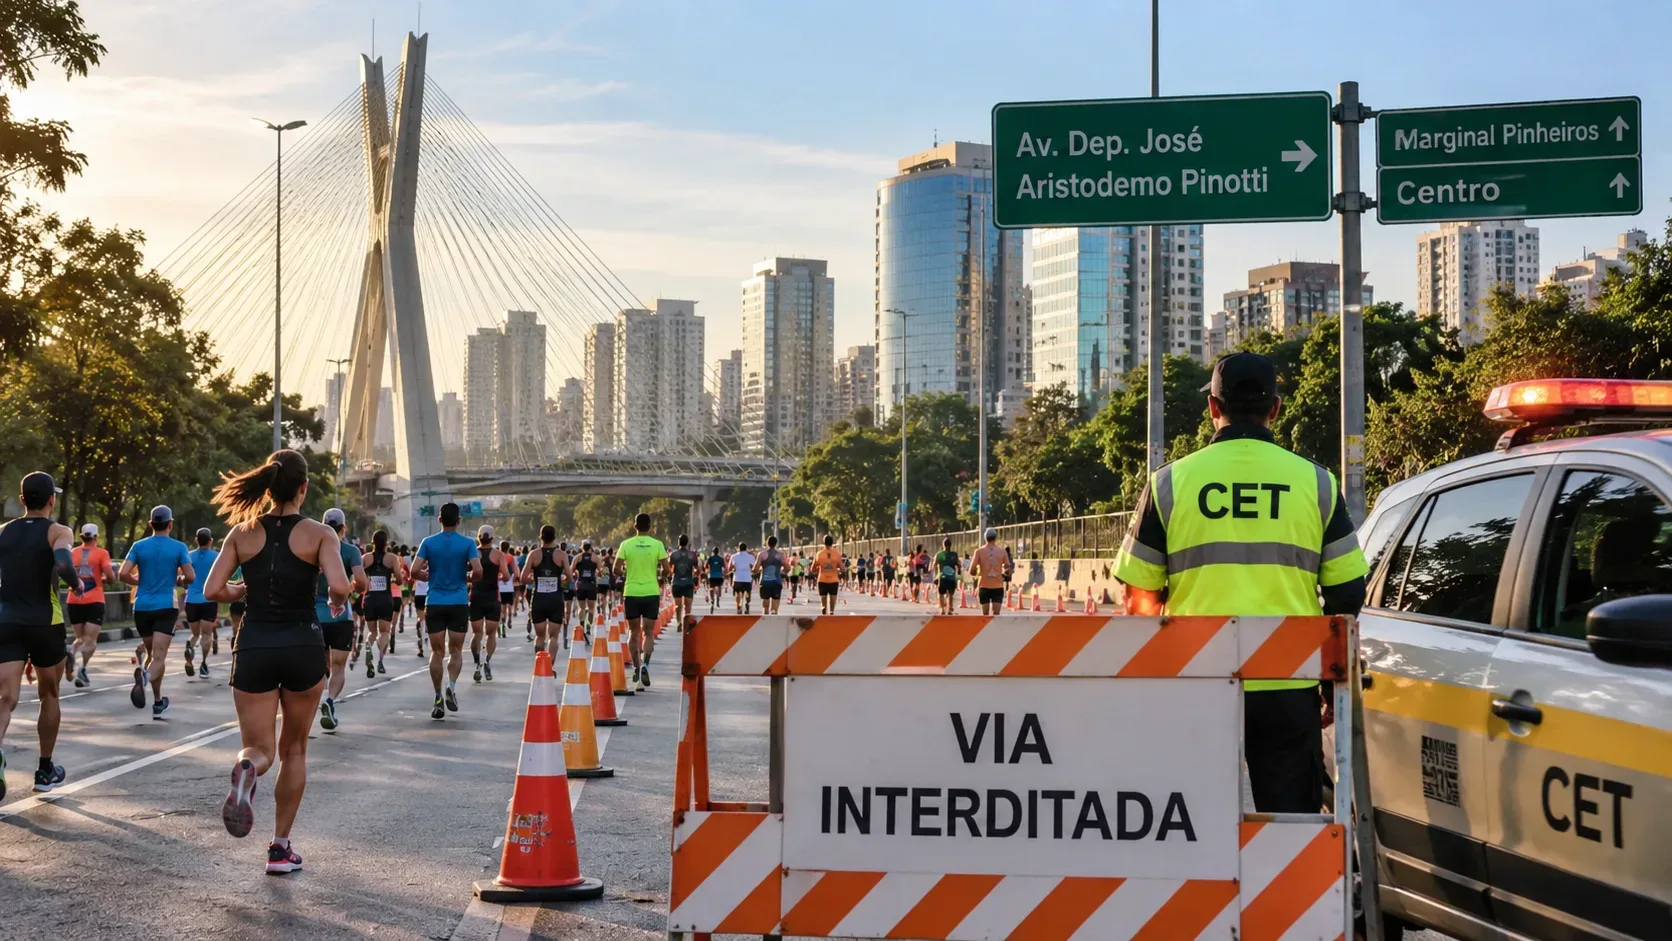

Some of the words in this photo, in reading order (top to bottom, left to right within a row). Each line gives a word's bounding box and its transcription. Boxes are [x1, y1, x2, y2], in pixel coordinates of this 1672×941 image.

[1016, 132, 1058, 157] Av.
[1069, 130, 1129, 161] Dep.
[1140, 126, 1203, 154] José
[1395, 124, 1495, 153] Marginal
[1503, 121, 1599, 145] Pinheiros
[1016, 171, 1172, 199] Aristodemo
[1182, 167, 1268, 195] Pinotti
[1397, 179, 1500, 205] Centro
[1198, 482, 1291, 519] CET
[949, 713, 1053, 765] VIA
[821, 785, 1198, 842] INTERDITADA
[1541, 766, 1634, 850] CET
